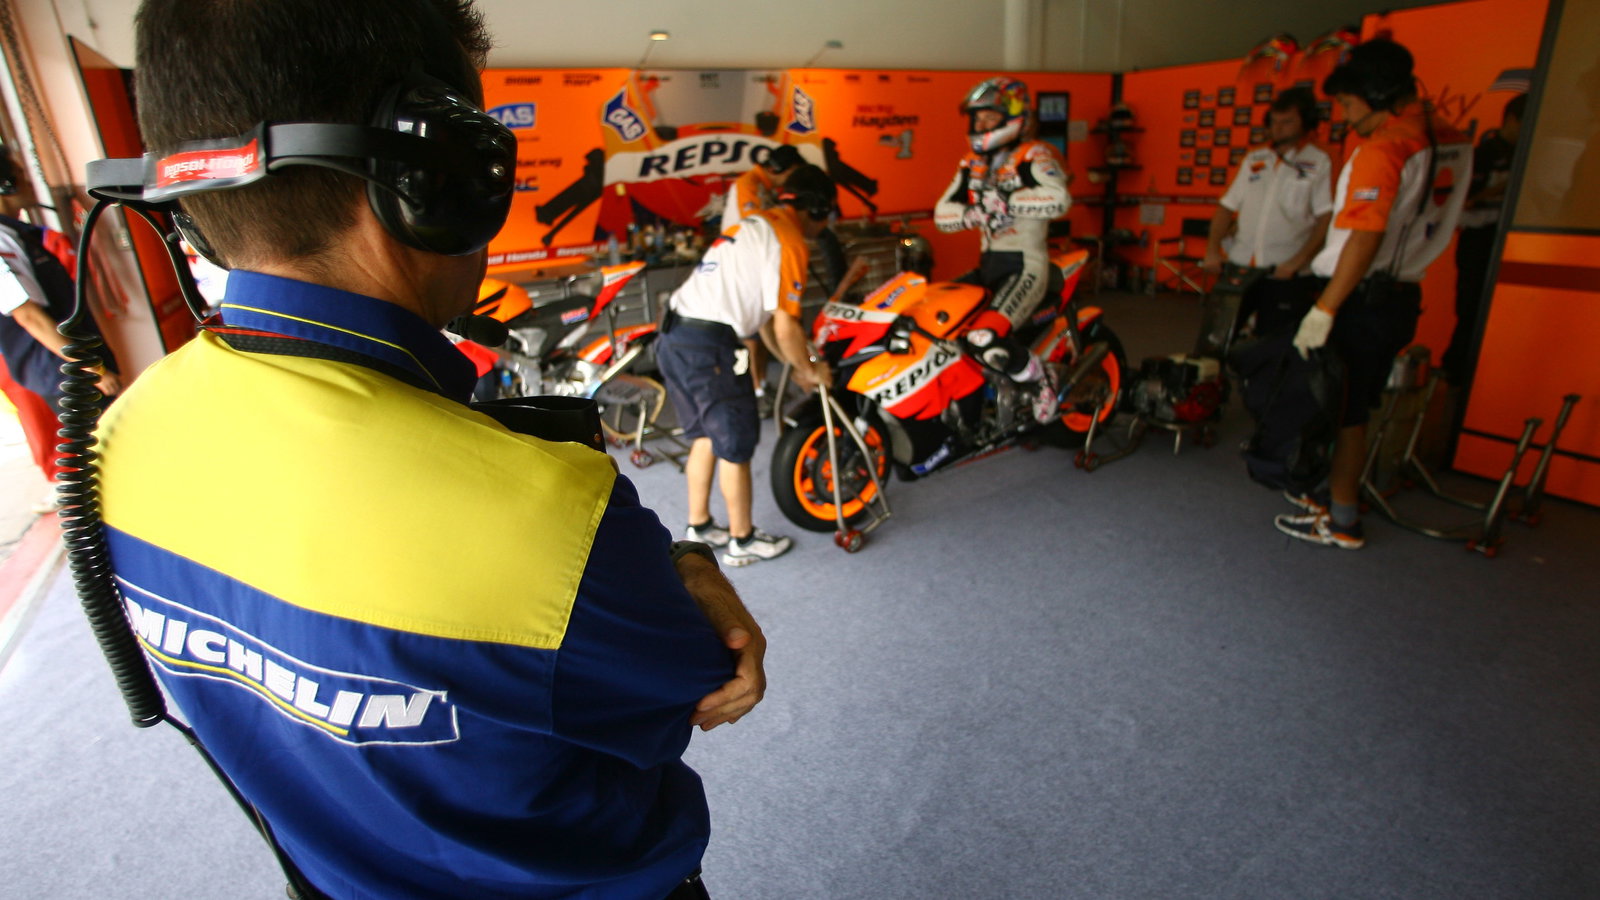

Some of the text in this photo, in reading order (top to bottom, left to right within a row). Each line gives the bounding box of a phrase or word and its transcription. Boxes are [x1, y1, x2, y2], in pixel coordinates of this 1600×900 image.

[607, 107, 644, 142] GAS
[852, 115, 920, 129] Hayden
[638, 140, 776, 177] REPSO
[506, 251, 548, 264] Honda
[827, 305, 865, 321] PSOL
[125, 596, 433, 729] MICHELIN
